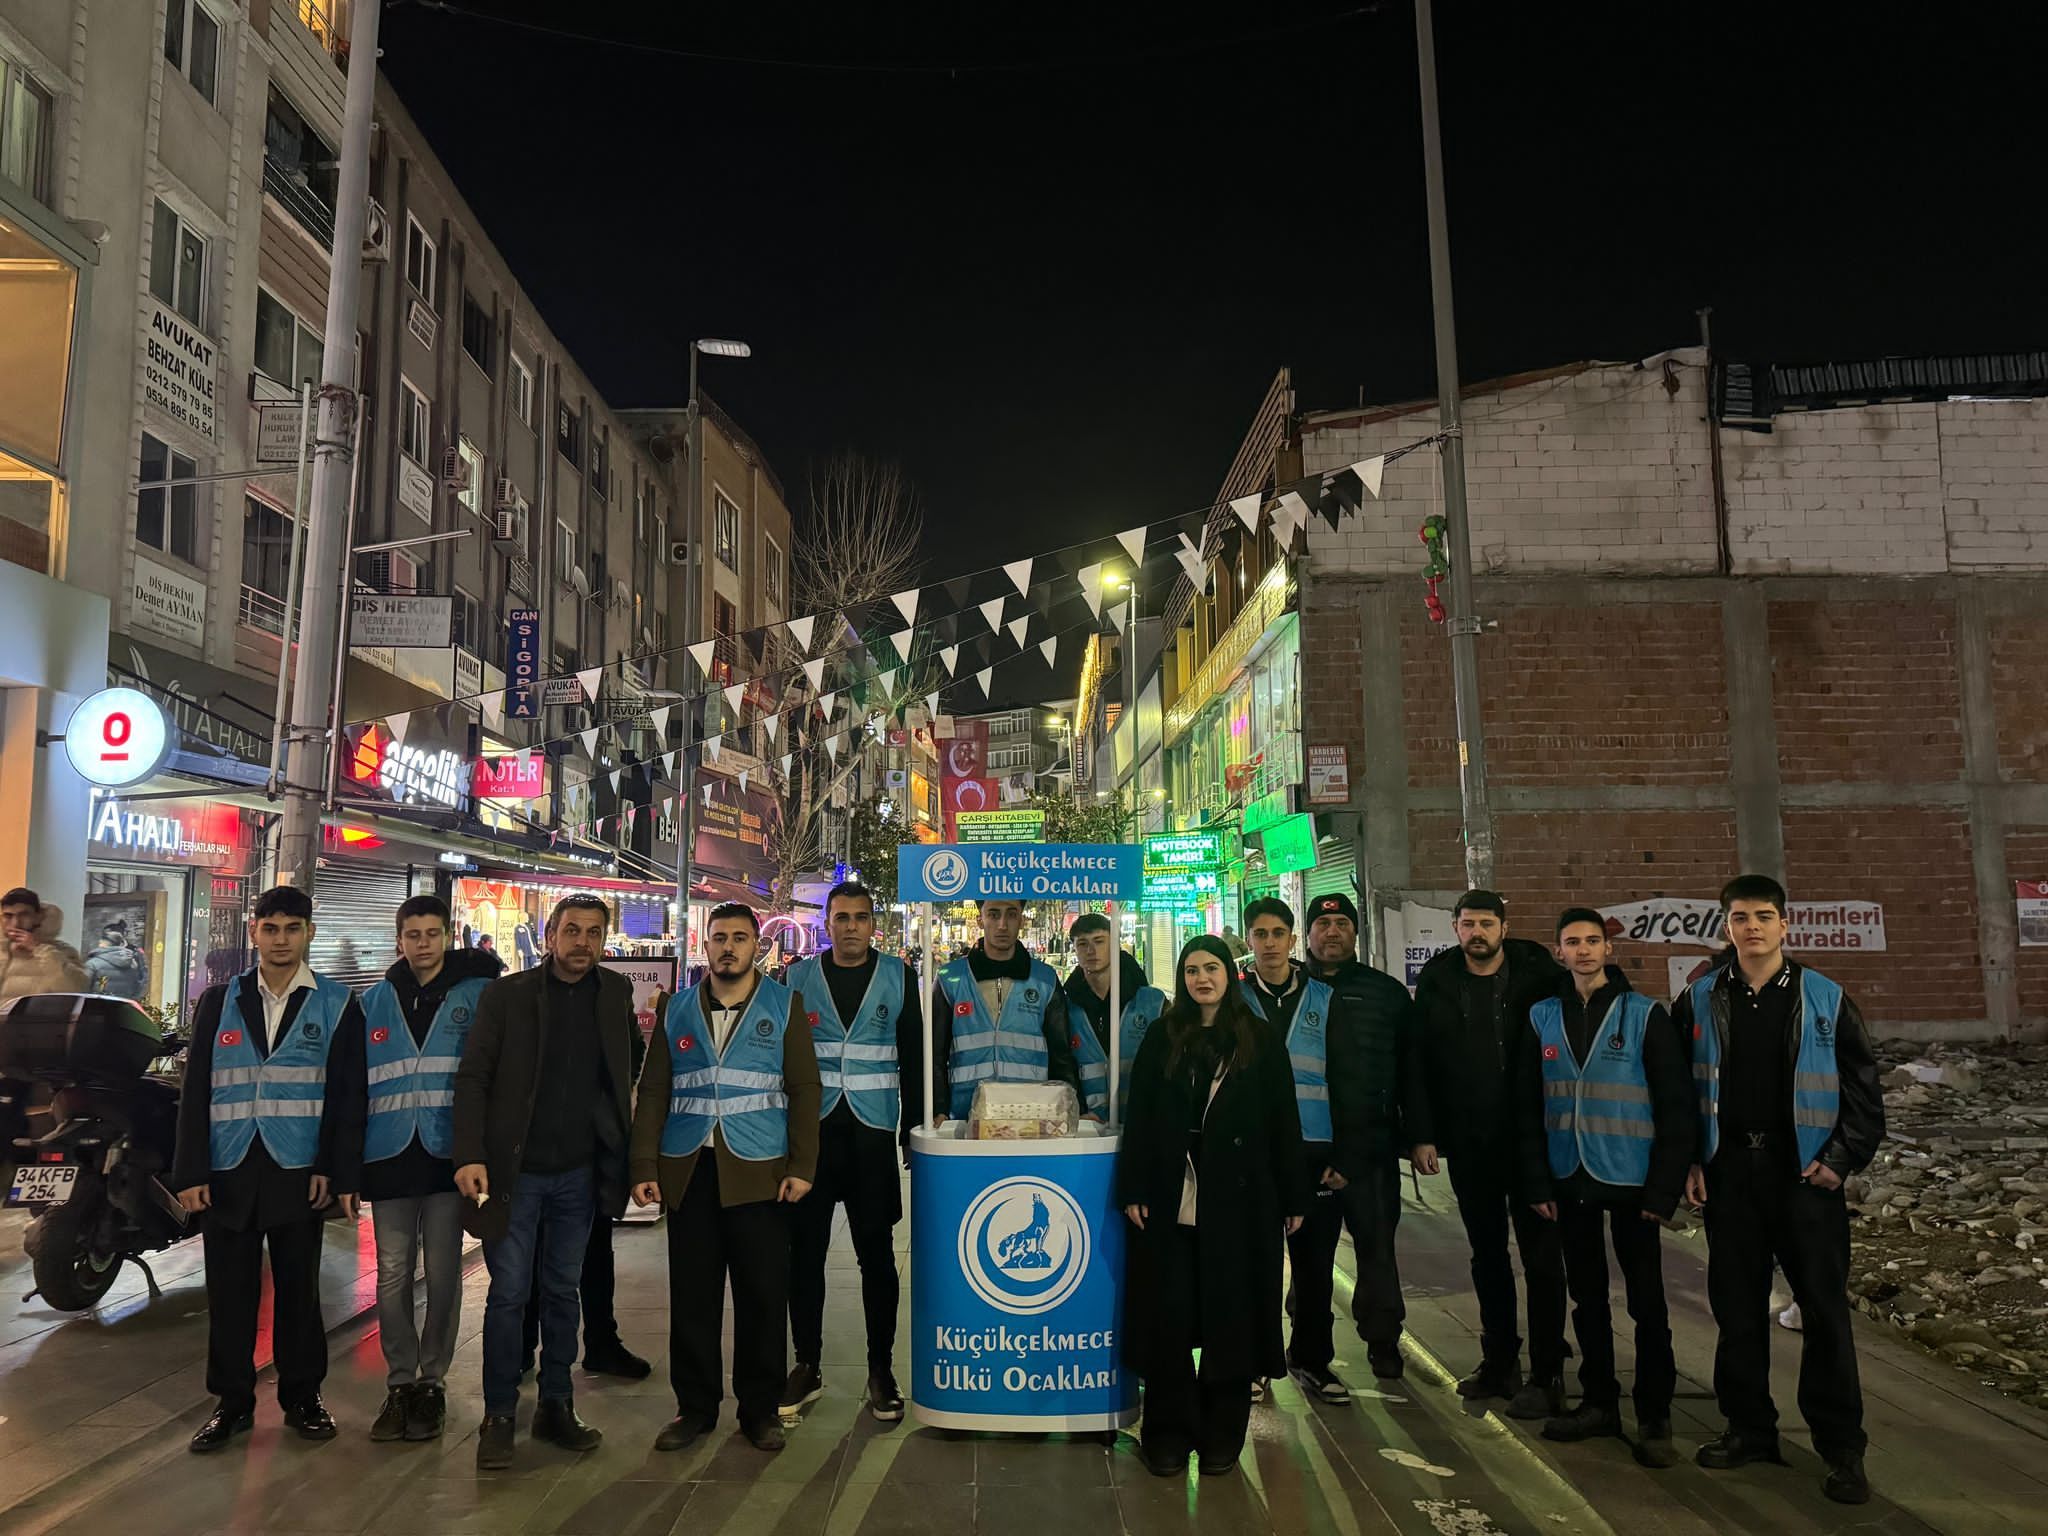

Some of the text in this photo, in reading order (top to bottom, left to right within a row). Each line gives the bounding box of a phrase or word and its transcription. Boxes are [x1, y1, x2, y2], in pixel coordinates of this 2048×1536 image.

[152, 310, 212, 367] AVUKAT
[148, 338, 213, 399] BEHZAT KÜLE
[146, 366, 213, 420] 0212 579 79 85
[146, 385, 213, 437] 0534 895 03 54
[149, 575, 194, 604] DİŞ HEKİMİ
[136, 584, 164, 609] Demet
[166, 599, 204, 625] AYMAN
[512, 611, 538, 620] CAN
[459, 652, 479, 680] AVUKAT
[546, 680, 579, 690] AVUKAT
[995, 813, 1040, 821] KİTABEVİ
[1151, 839, 1214, 851] NOTEBOOK
[1629, 905, 1724, 943] arçeli
[1405, 947, 1432, 961] SEFA
[17, 1168, 75, 1183] 34 KFB
[26, 1185, 56, 1199] 254
